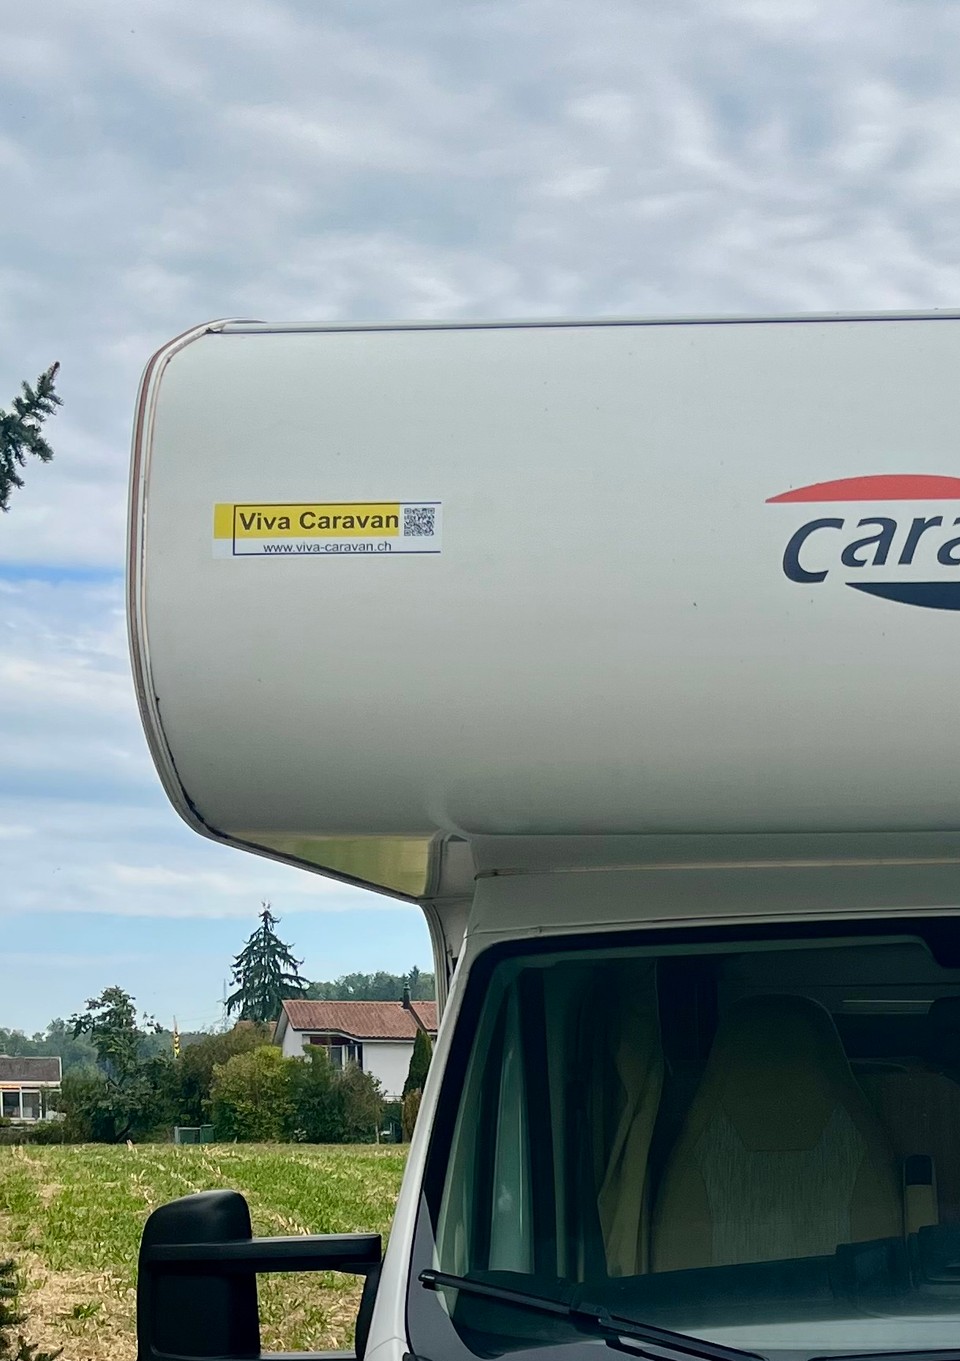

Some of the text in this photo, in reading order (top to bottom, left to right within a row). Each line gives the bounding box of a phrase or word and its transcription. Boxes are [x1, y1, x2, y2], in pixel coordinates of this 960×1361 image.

[239, 511, 399, 531] Viva Caravan
[263, 541, 392, 553] www.viva-caravan.ch
